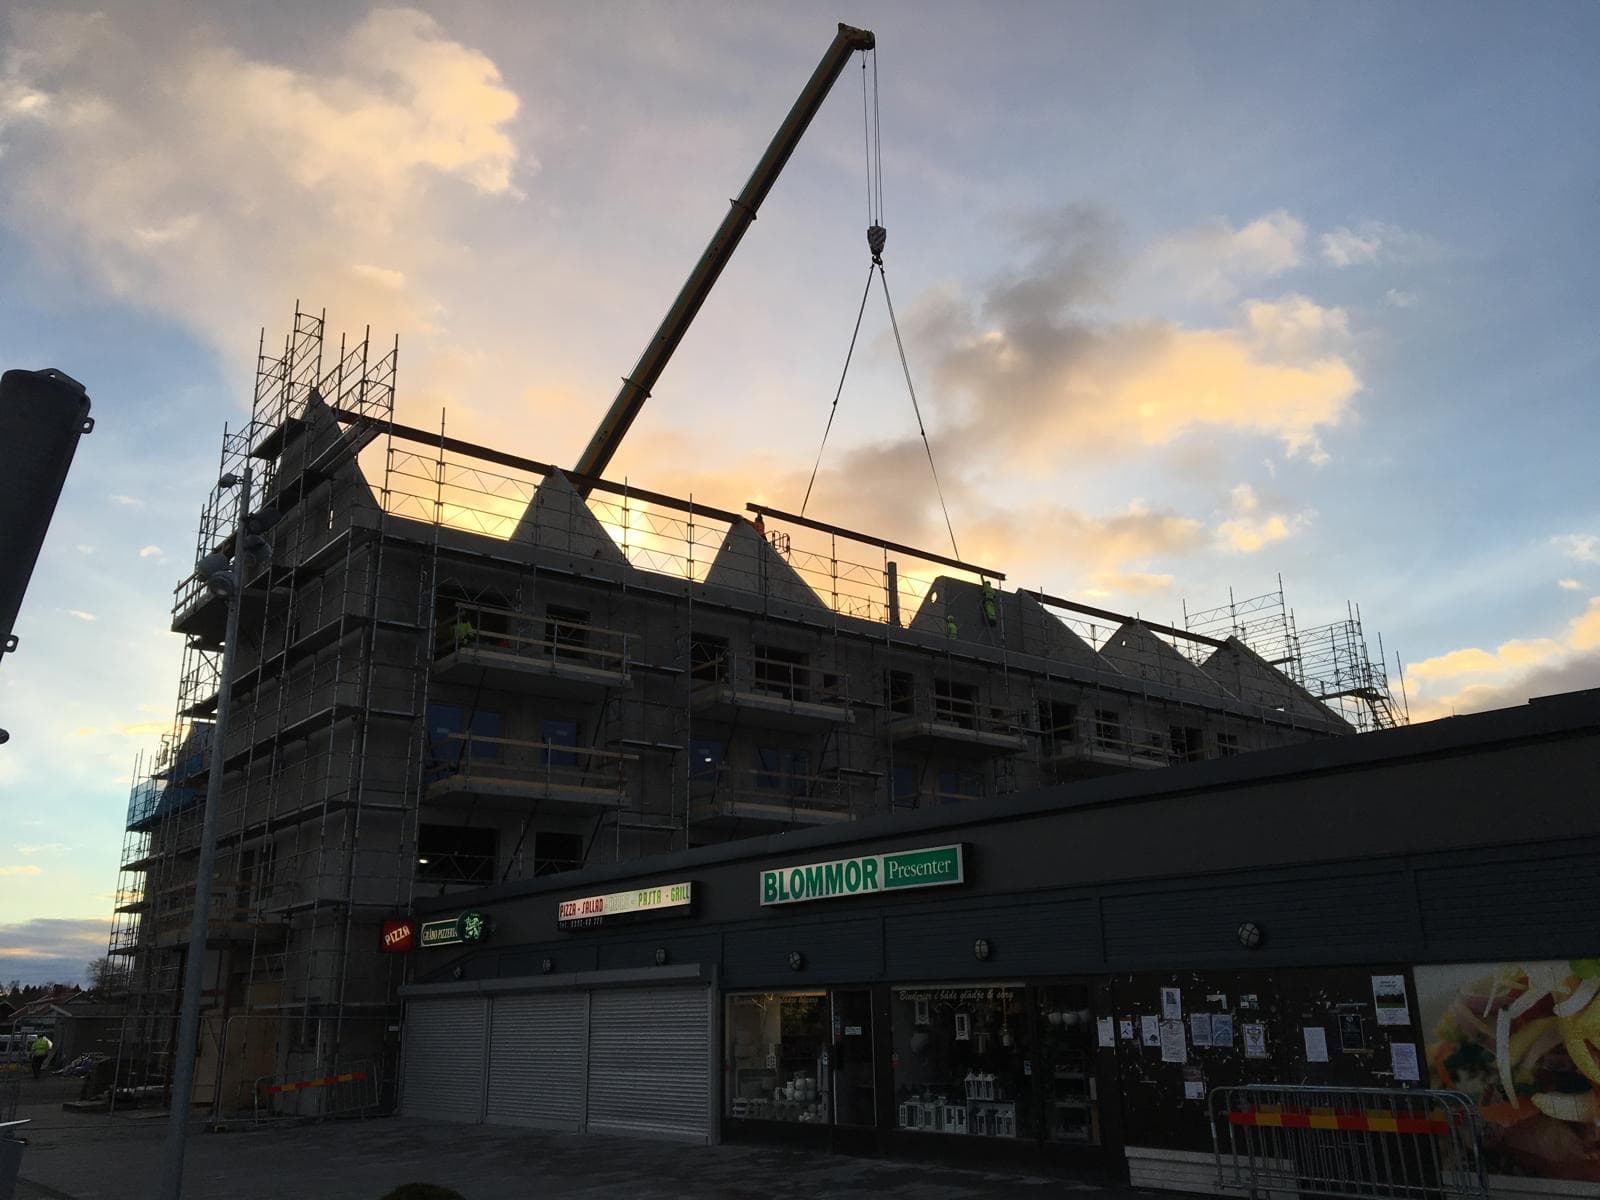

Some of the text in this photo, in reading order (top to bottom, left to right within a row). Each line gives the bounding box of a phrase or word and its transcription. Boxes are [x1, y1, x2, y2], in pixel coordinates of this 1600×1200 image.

[764, 858, 952, 903] BLOMMOR Presenter
[560, 903, 576, 918] PIZZA
[582, 899, 603, 914] SALLAD
[638, 890, 661, 906] PASTA
[671, 885, 690, 902] GRILL
[384, 925, 411, 946] PIZZA
